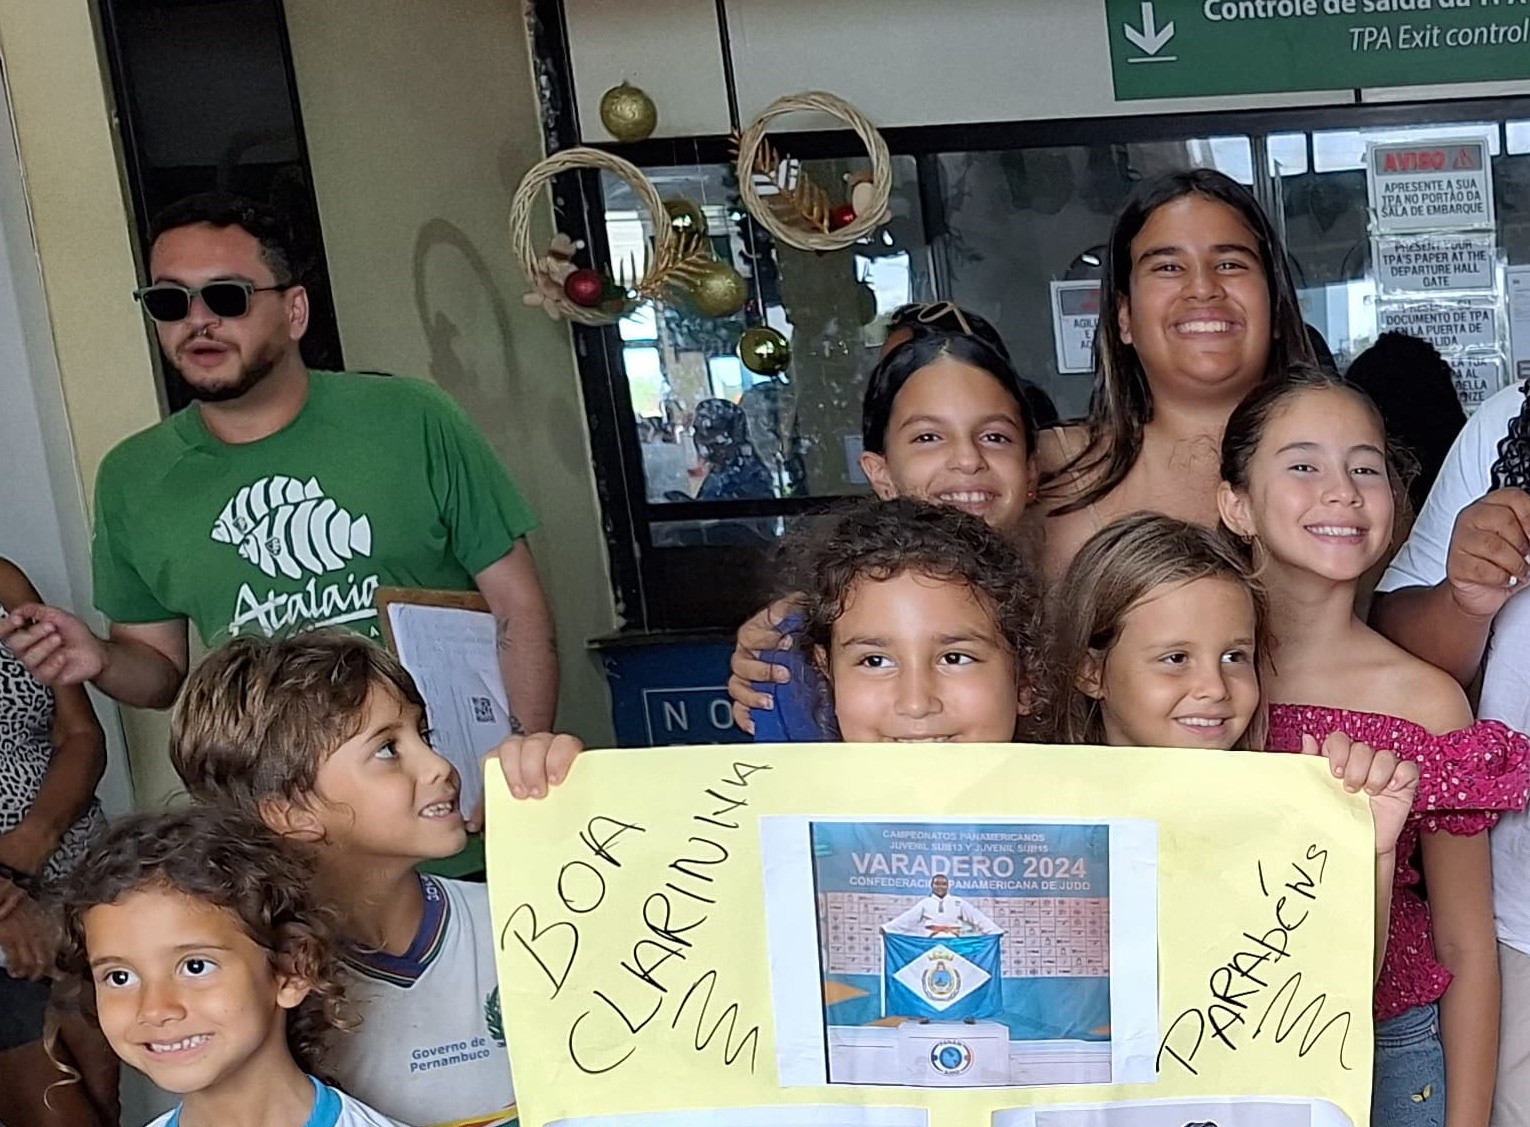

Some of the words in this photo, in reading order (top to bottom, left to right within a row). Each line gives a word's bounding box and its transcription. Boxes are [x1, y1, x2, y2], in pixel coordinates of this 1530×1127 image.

[1350, 27, 1392, 50] TPA
[1399, 24, 1441, 48] Exit
[1446, 18, 1530, 47] control
[1384, 180, 1443, 193] APRESENTE
[1456, 178, 1477, 189] SUA
[1381, 194, 1401, 206] TPA
[1404, 193, 1419, 204] NO
[1466, 191, 1481, 201] DA
[1381, 206, 1408, 218] SALA
[1410, 205, 1424, 216] DE
[1426, 202, 1484, 215] EMBARQUE
[1414, 252, 1449, 263] PAPER
[1451, 252, 1465, 262] AT
[1467, 250, 1486, 261] THE
[1390, 265, 1451, 277] DEPARTURE
[1453, 263, 1479, 274] HALL
[1386, 312, 1451, 325] DOCUMENTO
[1453, 312, 1467, 323] DE
[1469, 310, 1489, 322] TPA
[1426, 323, 1467, 335] PUERTA
[1468, 322, 1482, 333] DE
[883, 830, 957, 840] CAMPEONATOS
[962, 832, 1046, 841] PANAMERICANOS
[890, 842, 929, 851] JUVENIL
[851, 852, 1015, 878] VARADERO
[1022, 857, 1088, 878] 2024
[1041, 880, 1057, 891] DE
[501, 816, 646, 1000] BOA
[411, 1040, 467, 1060] Governo
[471, 1037, 486, 1048] de
[410, 1049, 490, 1073] Pernambuco
